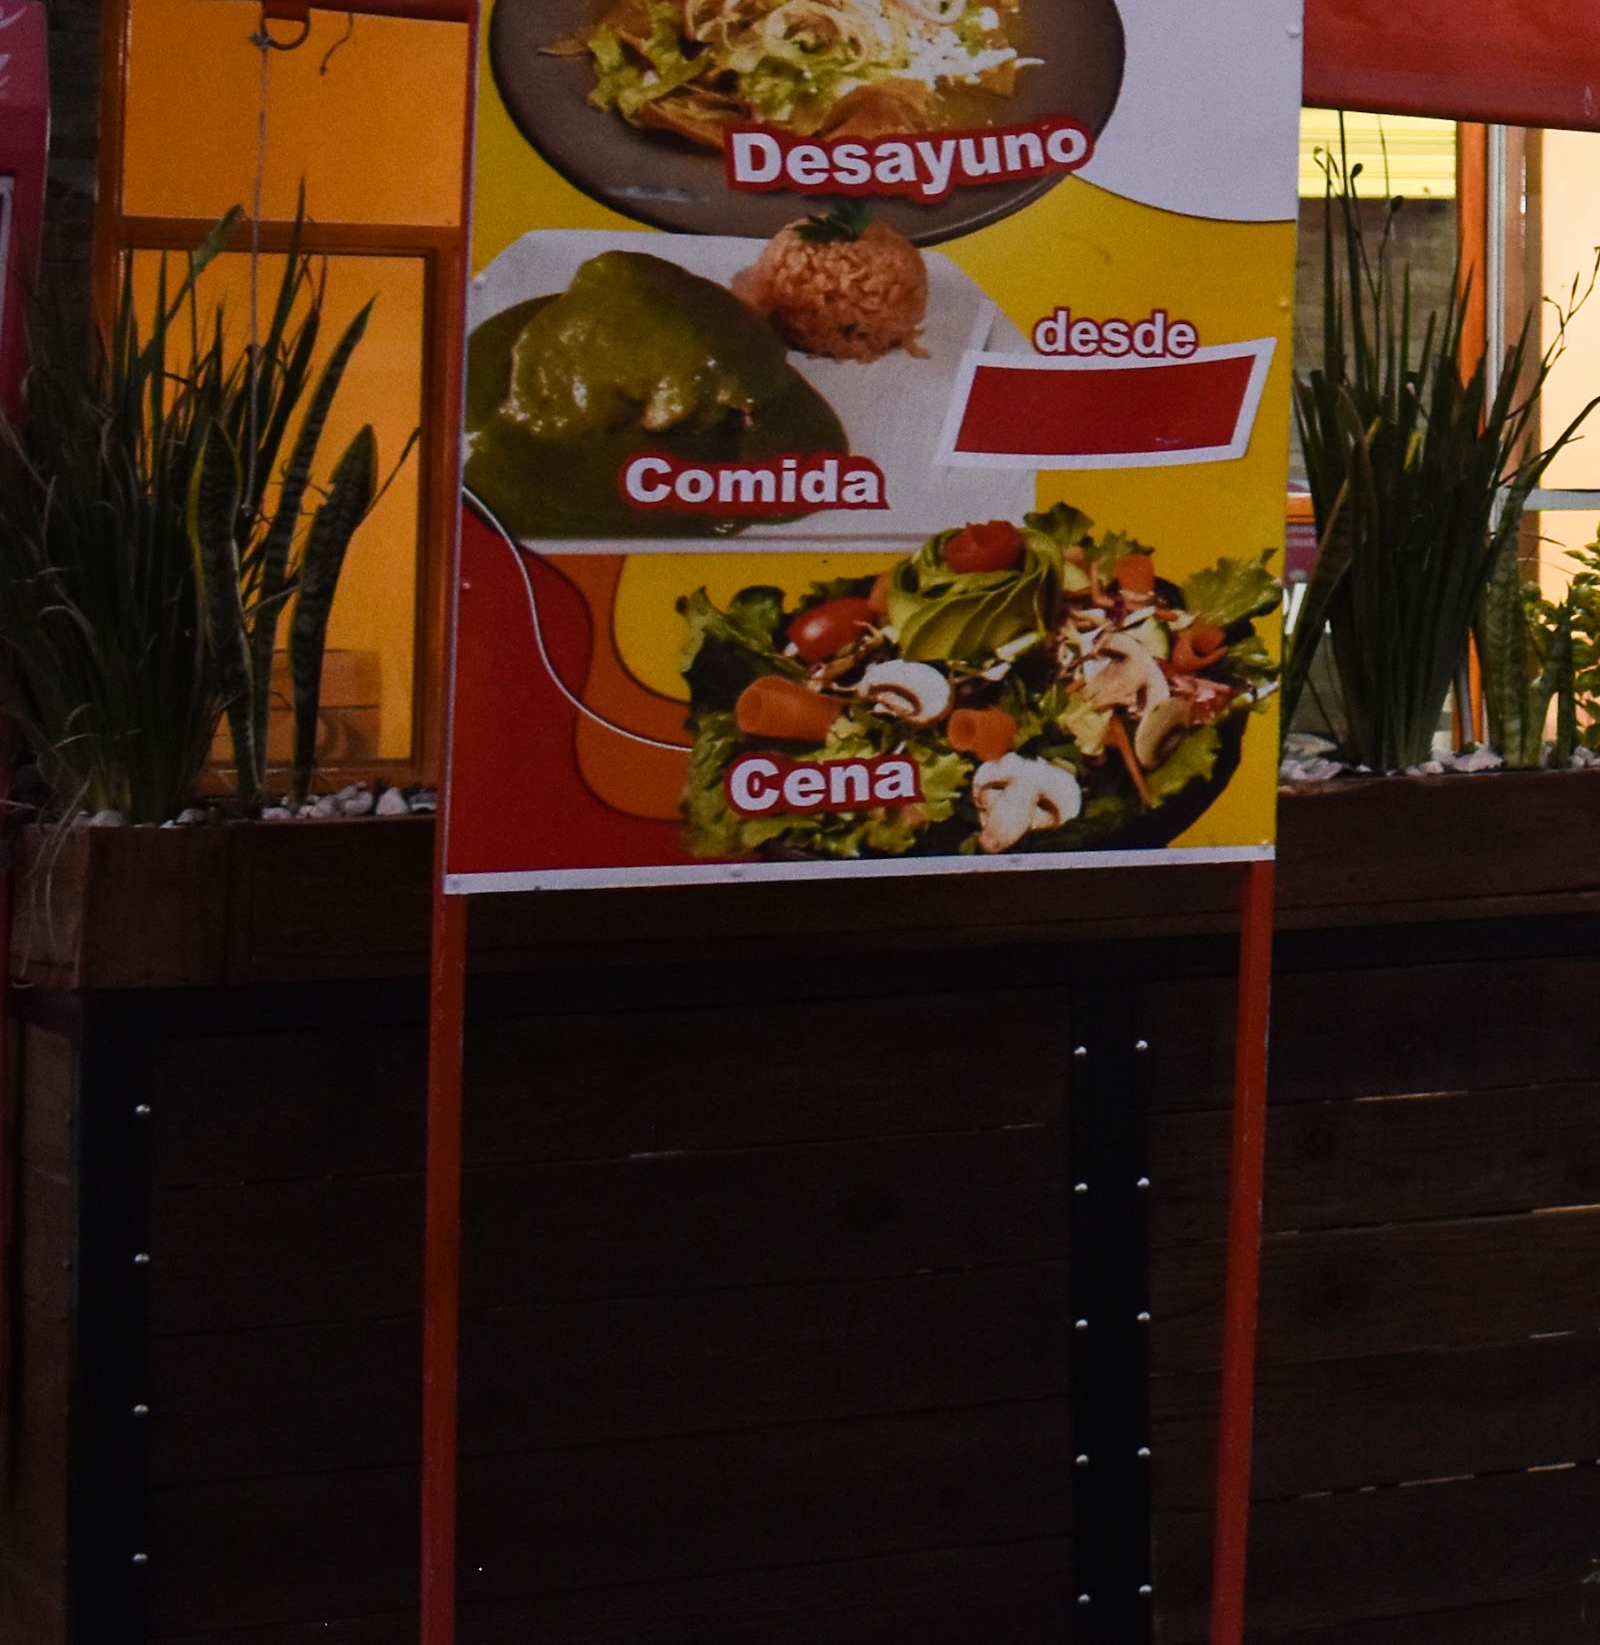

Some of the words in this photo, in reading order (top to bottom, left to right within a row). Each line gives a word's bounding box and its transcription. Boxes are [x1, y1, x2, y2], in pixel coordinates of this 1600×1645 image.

[731, 124, 1088, 195] Desayuno
[1035, 309, 1197, 356] desde
[624, 457, 881, 505] Comida
[729, 759, 917, 813] Cena
